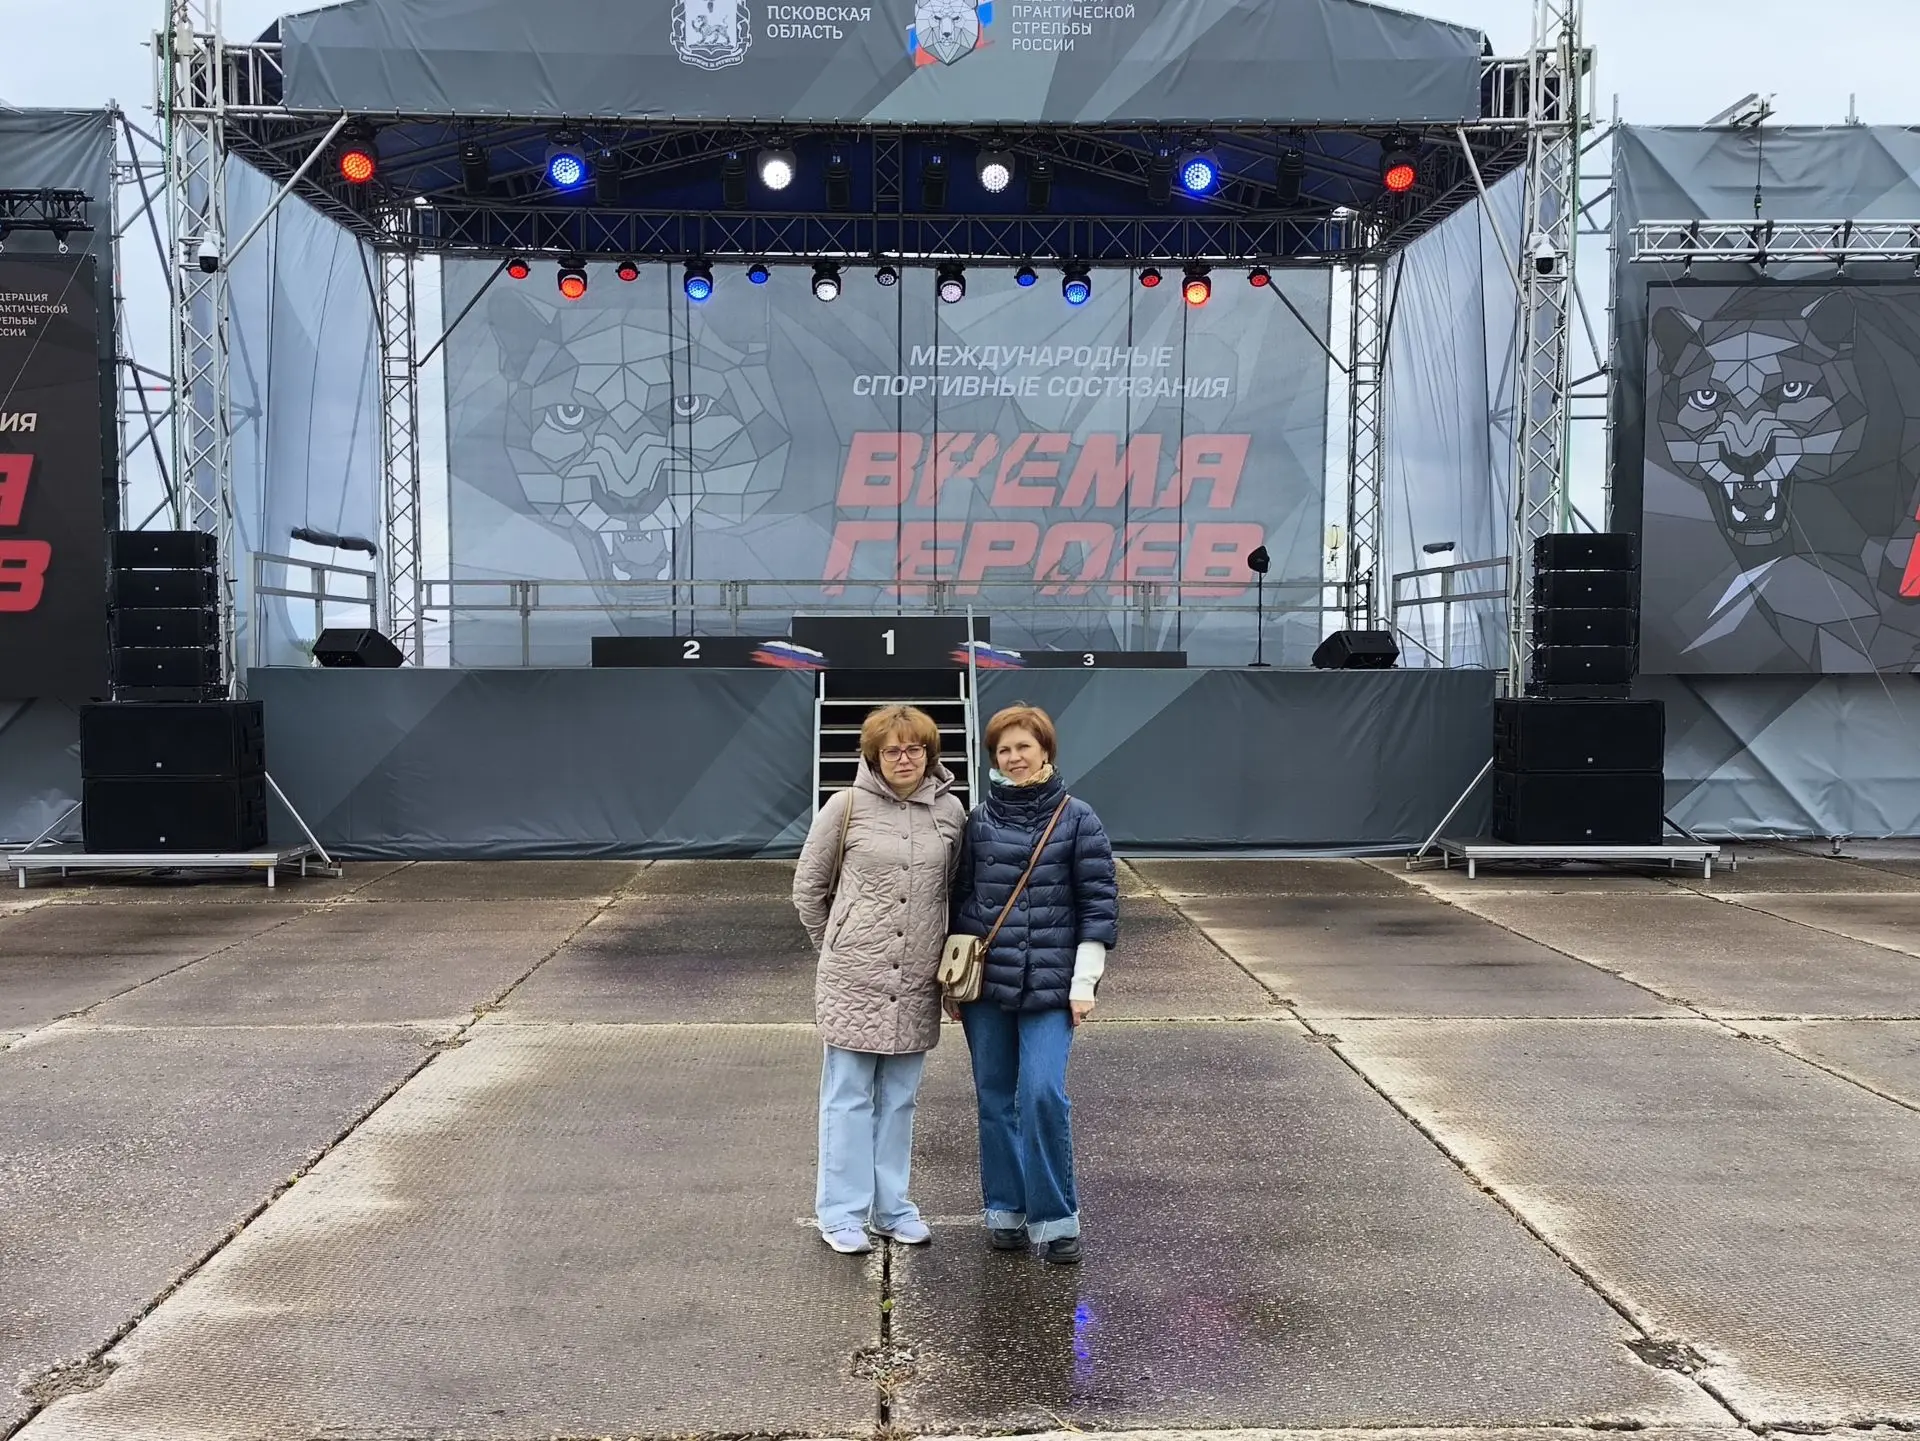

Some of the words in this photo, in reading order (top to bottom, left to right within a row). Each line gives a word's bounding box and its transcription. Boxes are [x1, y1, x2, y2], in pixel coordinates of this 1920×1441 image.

[766, 4, 872, 22] ПСКОВСКАЯ
[1011, 3, 1136, 19] ПРАКТИЧЕСКОЙ
[766, 23, 844, 40] ОБЛАСТЬ
[1011, 21, 1092, 36] СТРЕЛЬБЫ
[1011, 38, 1075, 52] РОССИИ
[0, 316, 37, 326] ЕЛЬБЫ
[909, 344, 1174, 371] МЕЖДУНАРОДНЫЕ
[852, 374, 1041, 398] СПОРТИВНЫЕ
[1047, 375, 1231, 399] СОСТЯЗАНИЯ
[835, 431, 1252, 509] ВРЕМЯ
[819, 520, 1265, 598] ГЕРОЕВ
[682, 640, 701, 660] 2
[882, 629, 895, 655] 1
[1082, 653, 1095, 667] 3
